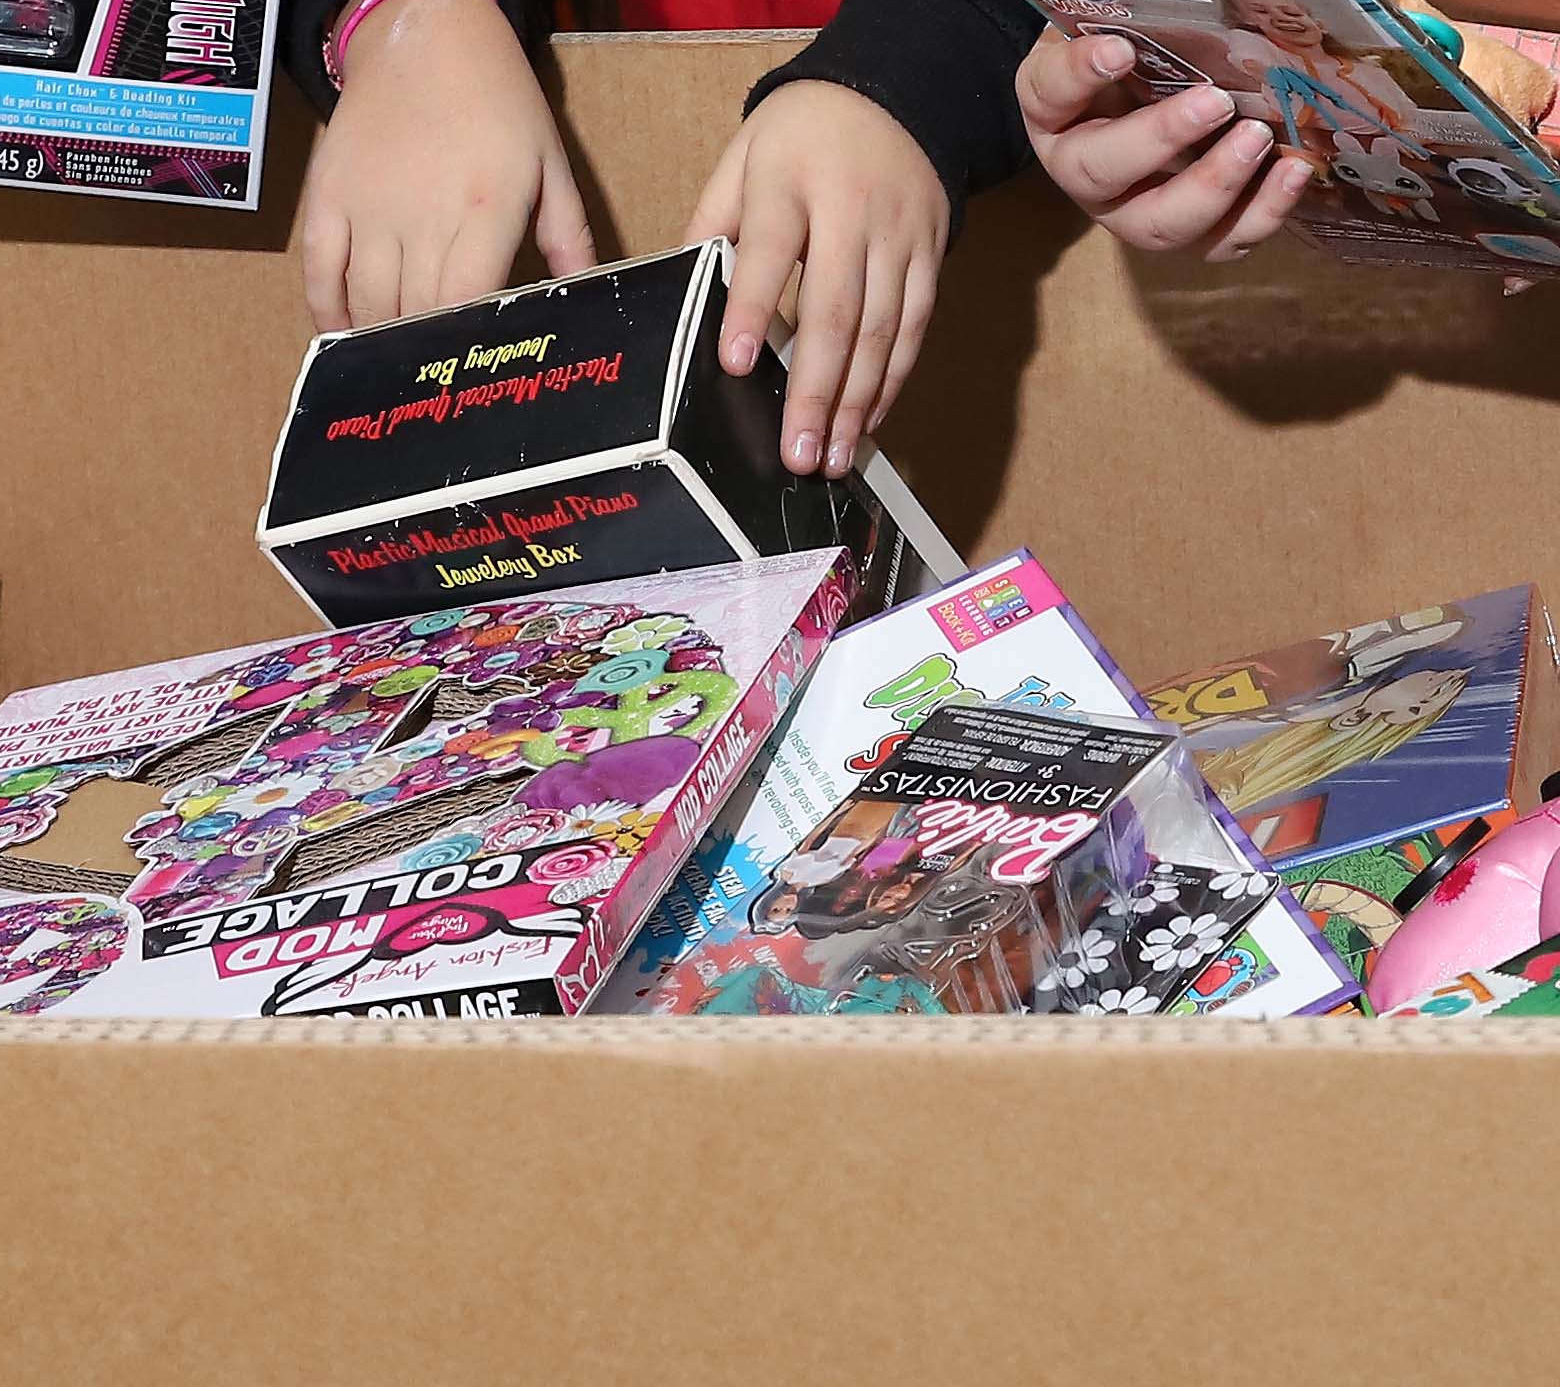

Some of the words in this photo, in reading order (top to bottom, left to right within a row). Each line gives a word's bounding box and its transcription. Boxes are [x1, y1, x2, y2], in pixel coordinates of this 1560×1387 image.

[2, 94, 15, 107] de
[120, 105, 133, 118] de
[35, 80, 64, 95] Hair
[122, 88, 173, 106] Beading
[177, 94, 197, 107] Kit
[23, 113, 37, 125] de
[126, 123, 140, 135] de
[25, 153, 45, 180] g)
[65, 160, 92, 173] Sans
[66, 151, 113, 165] Paraben
[114, 155, 138, 167] free
[64, 170, 83, 181] Sin
[464, 333, 557, 373] Jewelery
[416, 357, 459, 386] Box
[545, 352, 625, 392] Plastic
[453, 371, 542, 418] Musical
[326, 410, 386, 441] Piano
[386, 387, 452, 436] Grand
[326, 541, 415, 575] Plastic
[408, 517, 506, 556] Musical
[502, 500, 573, 543] Grand
[566, 491, 638, 522] Piano
[435, 555, 539, 589] Jewelery
[525, 542, 582, 568] Box
[959, 595, 994, 636] LEARNING
[56, 697, 102, 714] PAZ
[111, 689, 143, 703] LA
[153, 693, 182, 709] DE
[189, 682, 232, 701] KIT
[83, 702, 145, 722] ARTE
[118, 712, 164, 729] ART
[173, 701, 217, 720] KIT
[60, 733, 134, 758] WALL
[139, 720, 204, 743] PEACE
[698, 714, 751, 804] COLLAGE
[788, 729, 811, 760] Inside
[819, 775, 840, 801] find
[1038, 765, 1062, 779] 3+
[762, 780, 794, 829] revolting
[779, 763, 800, 788] with
[792, 787, 815, 815] gross
[872, 770, 1114, 809] FASHIONISTAS
[916, 799, 1100, 885] Barbie
[713, 865, 747, 898] STEM
[165, 857, 521, 953] COLLAGE
[225, 914, 387, 972] MOD
[449, 934, 554, 967] Fashion
[330, 958, 438, 998] Angels
